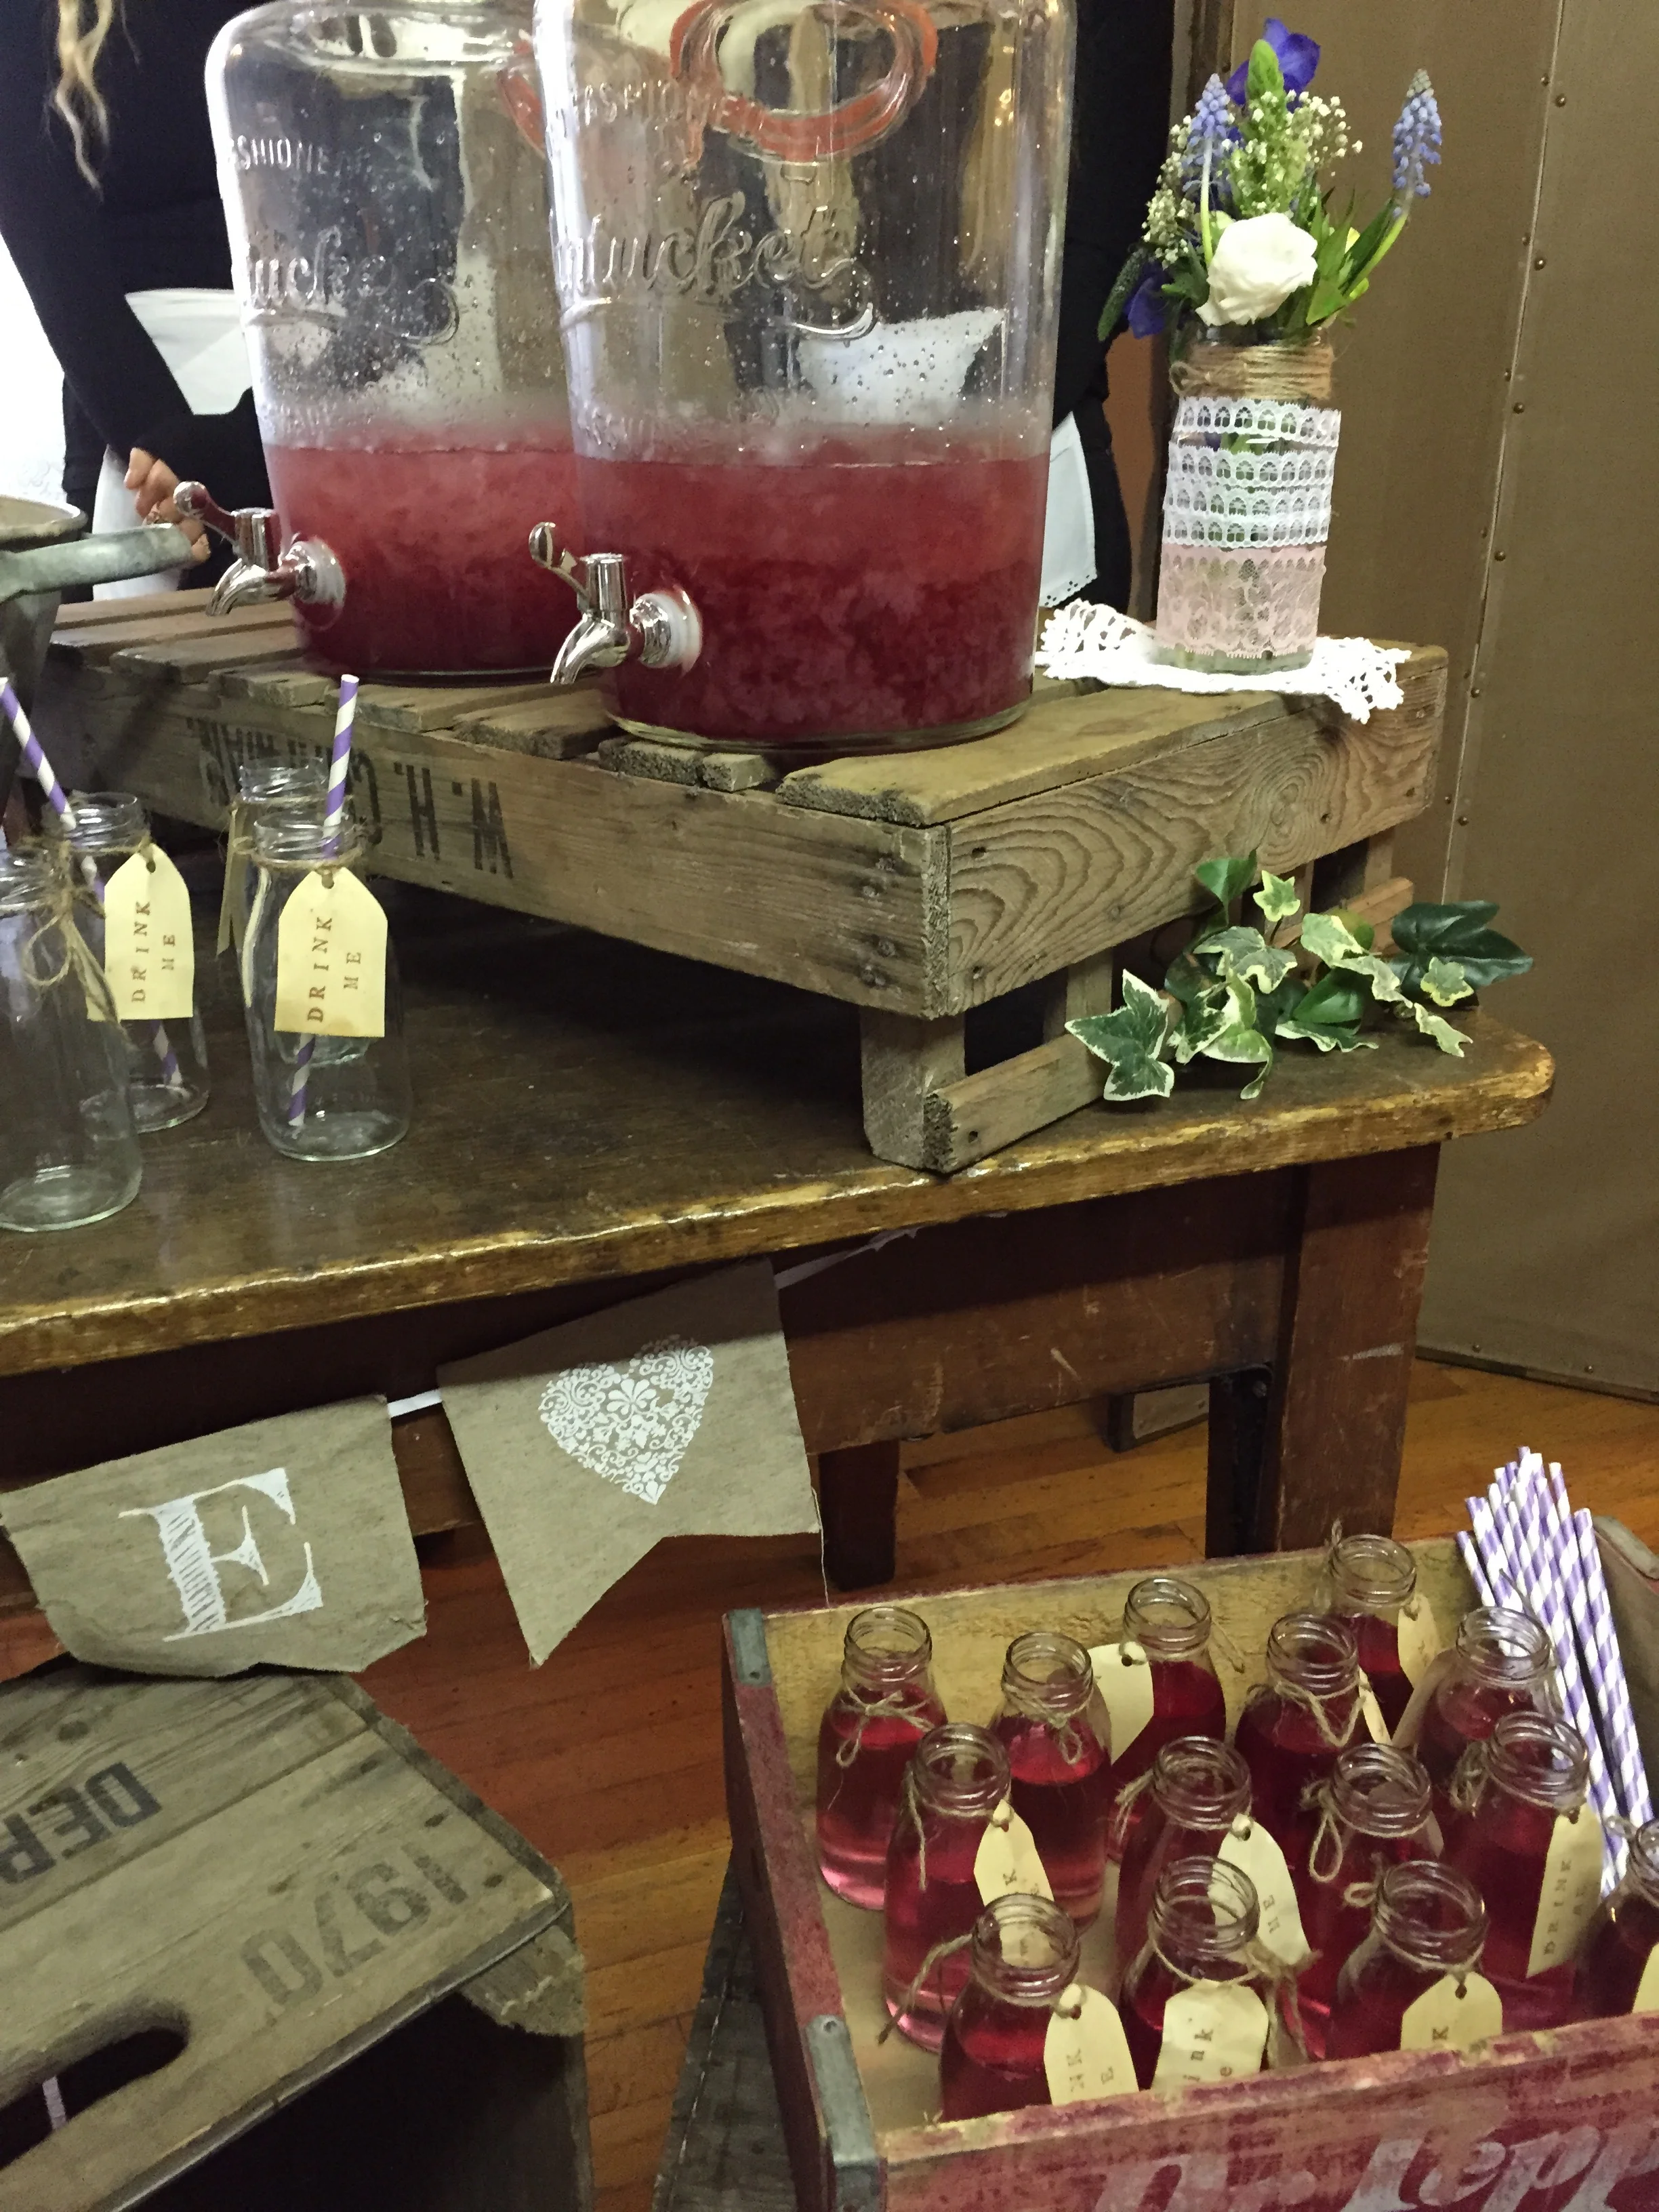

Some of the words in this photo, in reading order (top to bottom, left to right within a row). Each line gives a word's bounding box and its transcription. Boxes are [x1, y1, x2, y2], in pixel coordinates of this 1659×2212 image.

[131, 901, 150, 1003] DRINK
[307, 916, 332, 1023] DRINK
[343, 951, 361, 990] ME
[118, 1467, 323, 1641] E
[1183, 2028, 1214, 2083] ink
